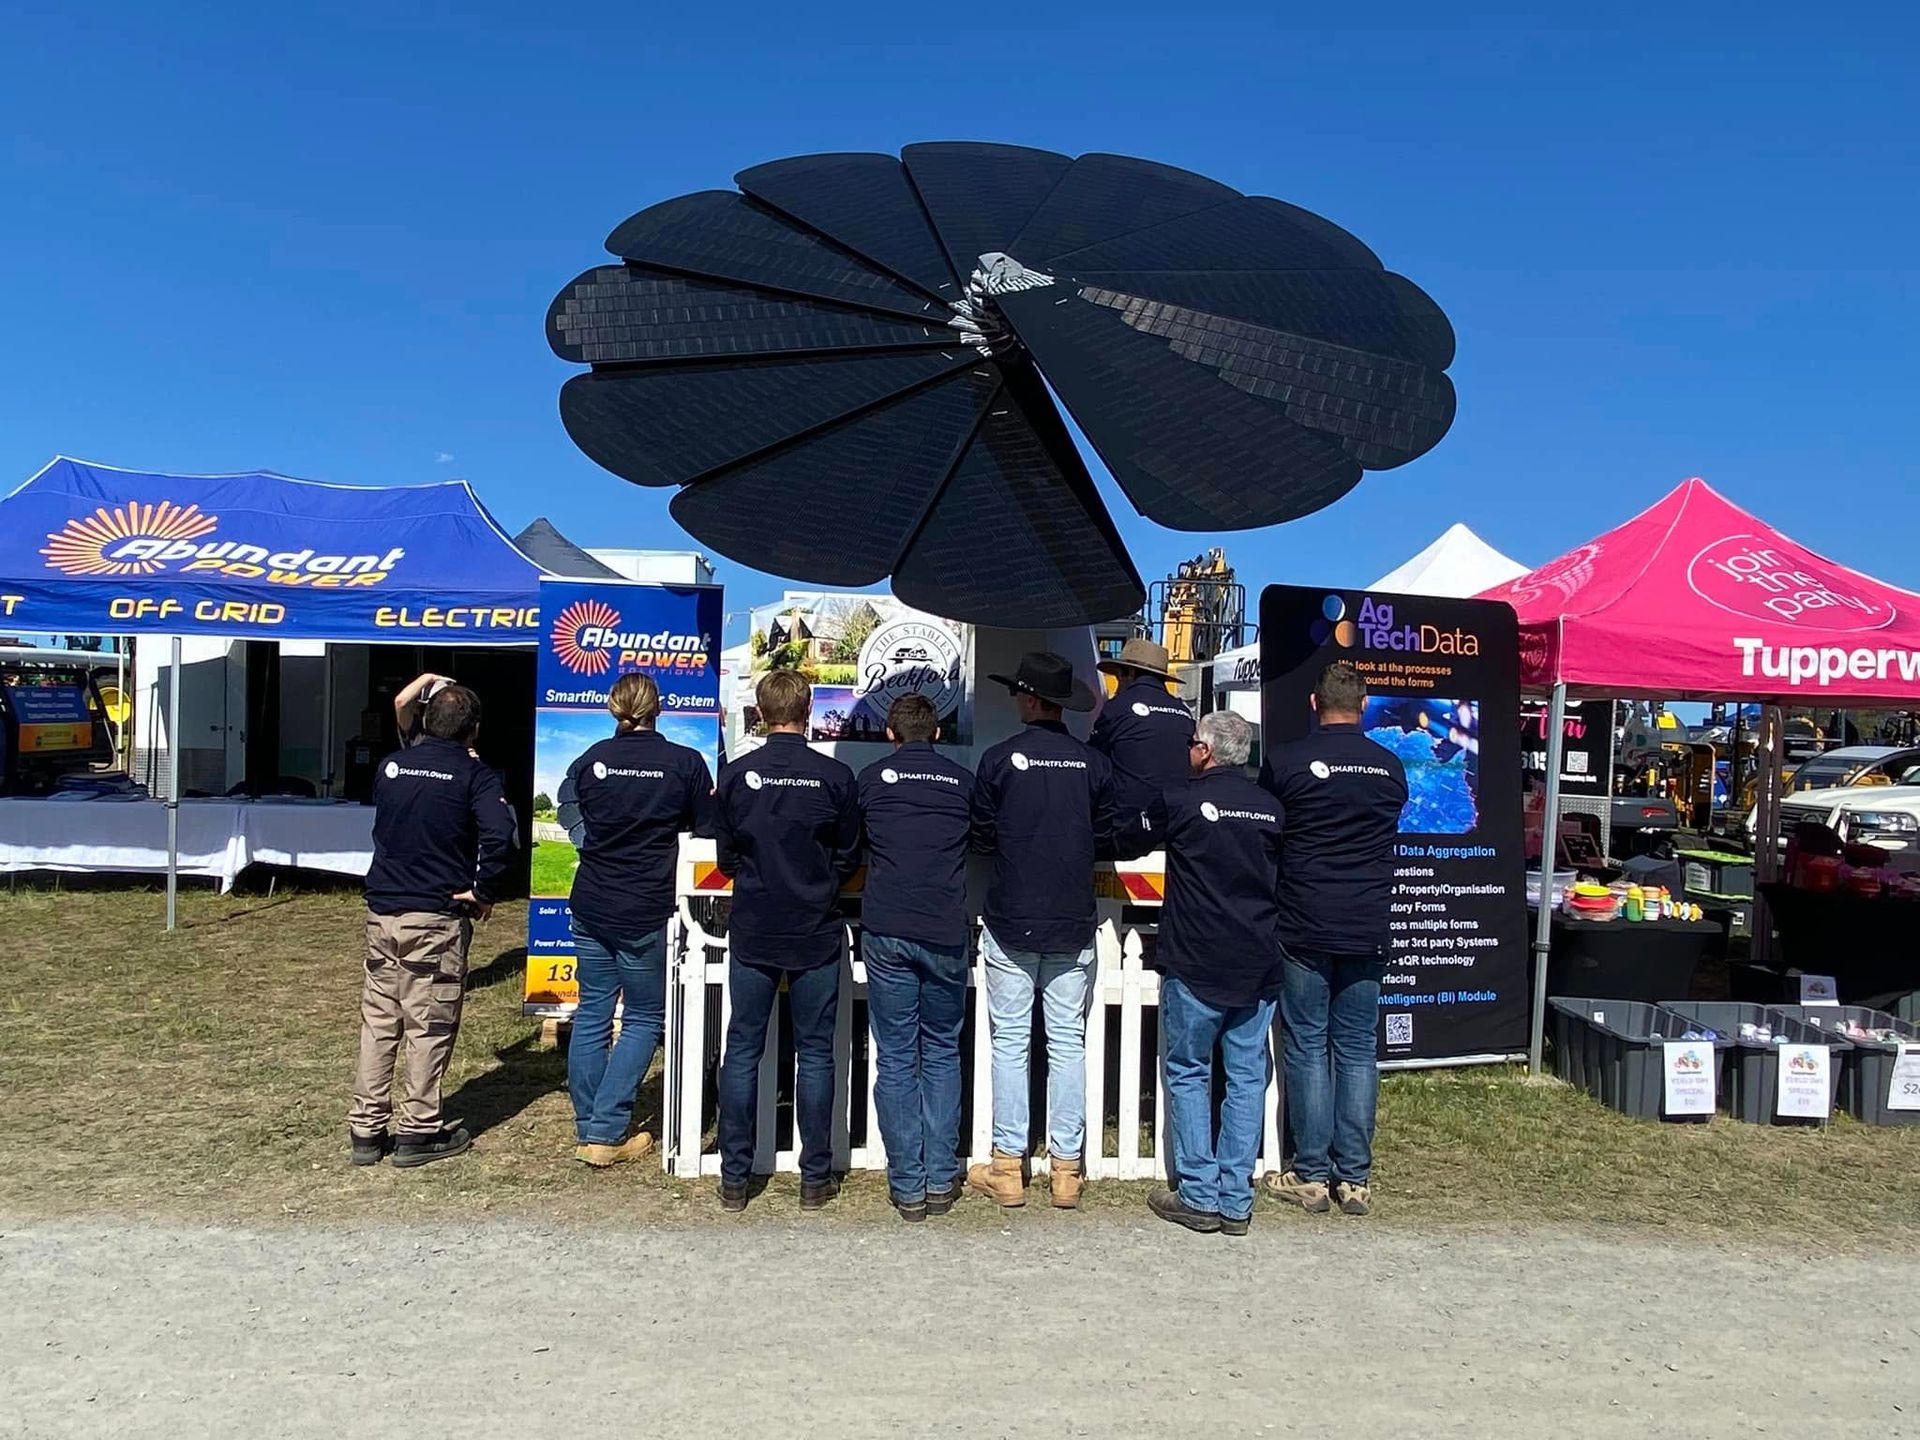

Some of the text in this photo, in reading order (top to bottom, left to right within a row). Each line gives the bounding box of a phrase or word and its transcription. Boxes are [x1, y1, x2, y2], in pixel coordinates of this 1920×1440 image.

[110, 538, 406, 573] Abundant
[180, 559, 388, 587] POWER
[110, 598, 183, 619] OFF
[195, 601, 286, 623] GRID
[1358, 597, 1394, 630] Ag
[581, 627, 711, 651] Abundant
[874, 626, 954, 656] THE STABLES
[1358, 623, 1479, 656] TechData
[618, 651, 708, 668] POWER
[1355, 661, 1376, 671] look
[1378, 663, 1387, 672] at
[1388, 662, 1403, 673] the
[1405, 664, 1452, 675] processes
[856, 662, 960, 694] Beckford
[1364, 676, 1434, 688] ound the forms
[667, 694, 715, 709] System
[1029, 759, 1086, 769] SMARTFLOWER
[399, 768, 453, 780] SMARTFLOWER
[608, 768, 664, 779] SMARTFLOWER
[899, 773, 959, 785] SMARTFLOWER
[762, 777, 820, 788] SMARTFLOWER
[1219, 809, 1276, 822] SMARTFLOWER
[1400, 844, 1424, 856] Data
[1426, 845, 1496, 859] Aggregation
[1393, 867, 1434, 877] uestions
[1399, 884, 1505, 896] Property/Organisation
[1415, 901, 1446, 912] Forms
[1390, 919, 1479, 931] oss multiple forms
[1411, 937, 1428, 948] 3rd
[1429, 938, 1454, 949] party
[1456, 936, 1498, 949] Systems
[1421, 954, 1475, 966] technology
[1382, 974, 1416, 986] rfacing
[1377, 990, 1497, 1006] ntelligence (BI) Module
[1903, 1083, 1920, 1095] $2
